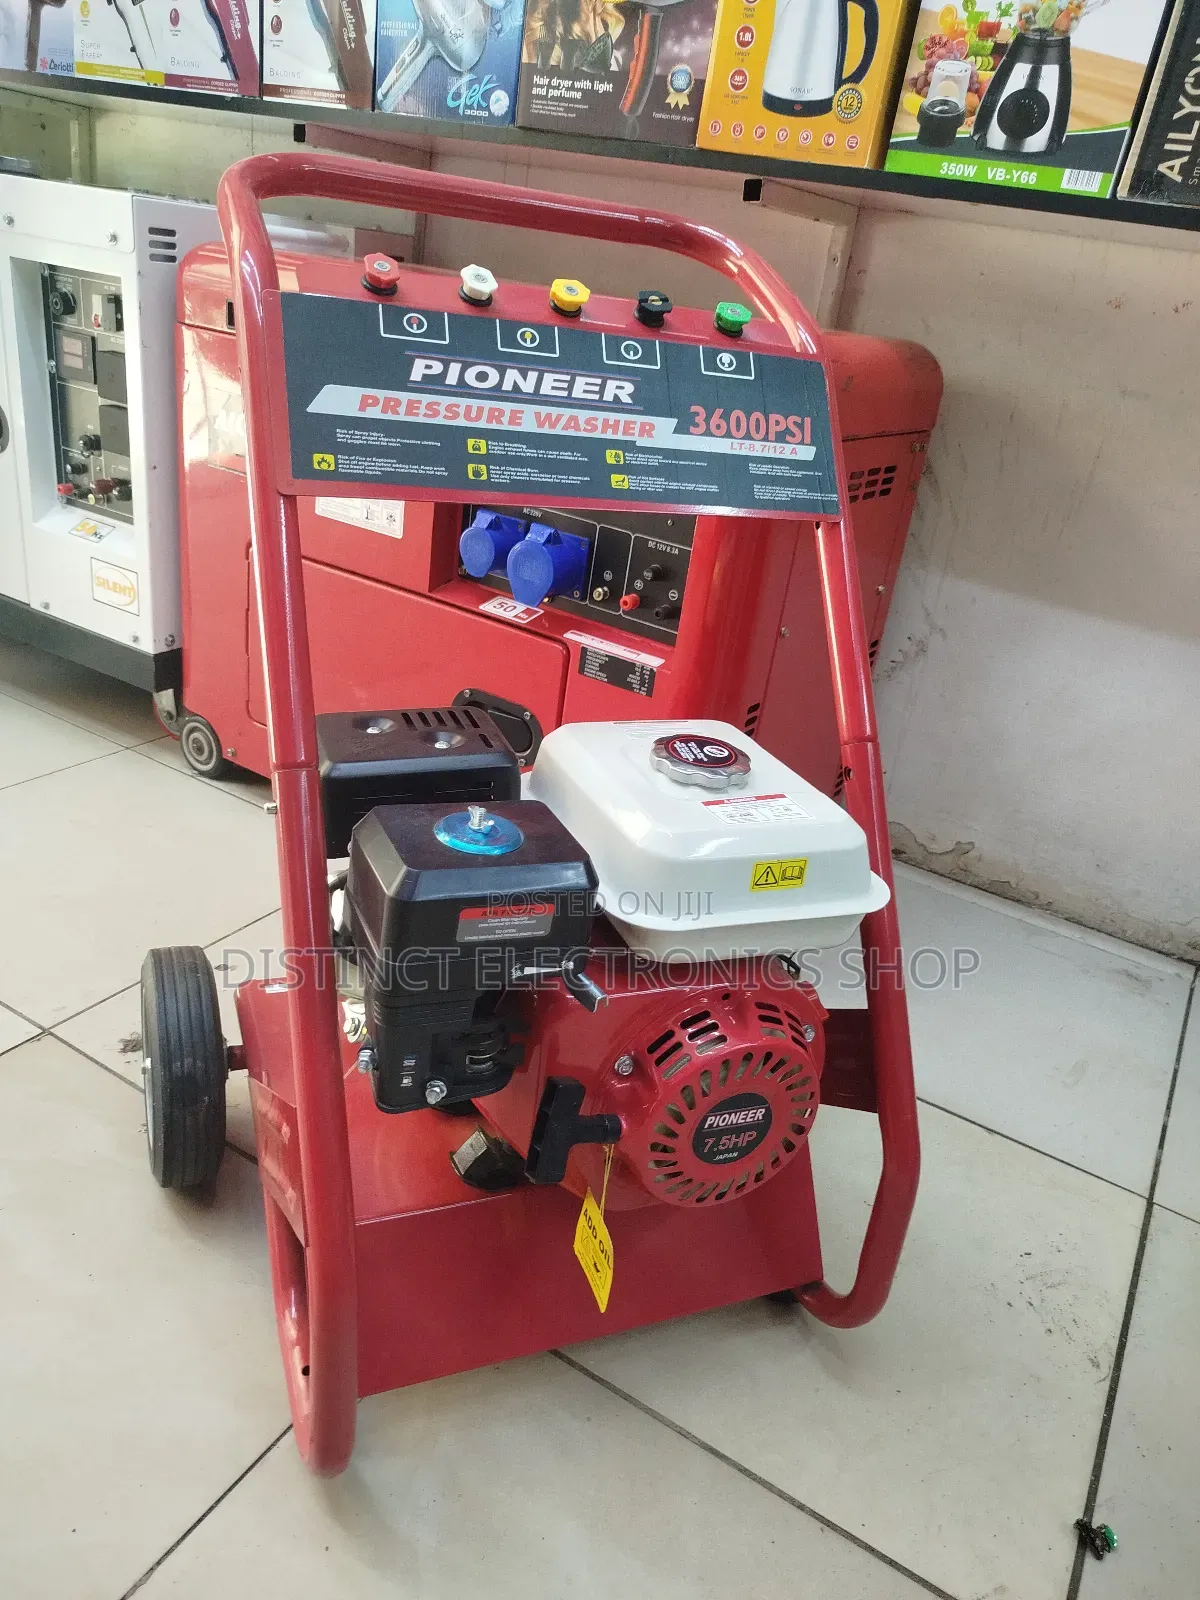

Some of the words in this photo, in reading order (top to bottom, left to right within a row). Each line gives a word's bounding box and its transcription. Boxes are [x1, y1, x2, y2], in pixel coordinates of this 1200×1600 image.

[532, 86, 546, 95] and
[549, 88, 582, 99] perfume
[533, 75, 549, 85] Hair
[551, 77, 573, 89] dryer
[574, 80, 592, 89] with
[594, 82, 613, 93] light
[844, 95, 856, 107] 12
[1156, 37, 1200, 183] AILYO
[652, 111, 670, 120] Fashion
[682, 115, 695, 123] dryer
[940, 161, 978, 178] 350W
[987, 166, 1038, 186] VB-Y66
[409, 358, 635, 404] PIONEER
[357, 393, 525, 427] PRESSURE
[534, 411, 657, 439] WASHER
[689, 405, 811, 445] 3600PSI
[789, 446, 799, 456] A
[648, 540, 656, 549] DC
[95, 575, 134, 599] SILENT
[492, 601, 518, 613] 50
[703, 1108, 766, 1129] PIONEER
[703, 1130, 757, 1153] 7.5HP
[712, 1151, 739, 1161] JAPAN
[583, 1207, 598, 1240] ADD
[598, 1239, 611, 1270] OIL
